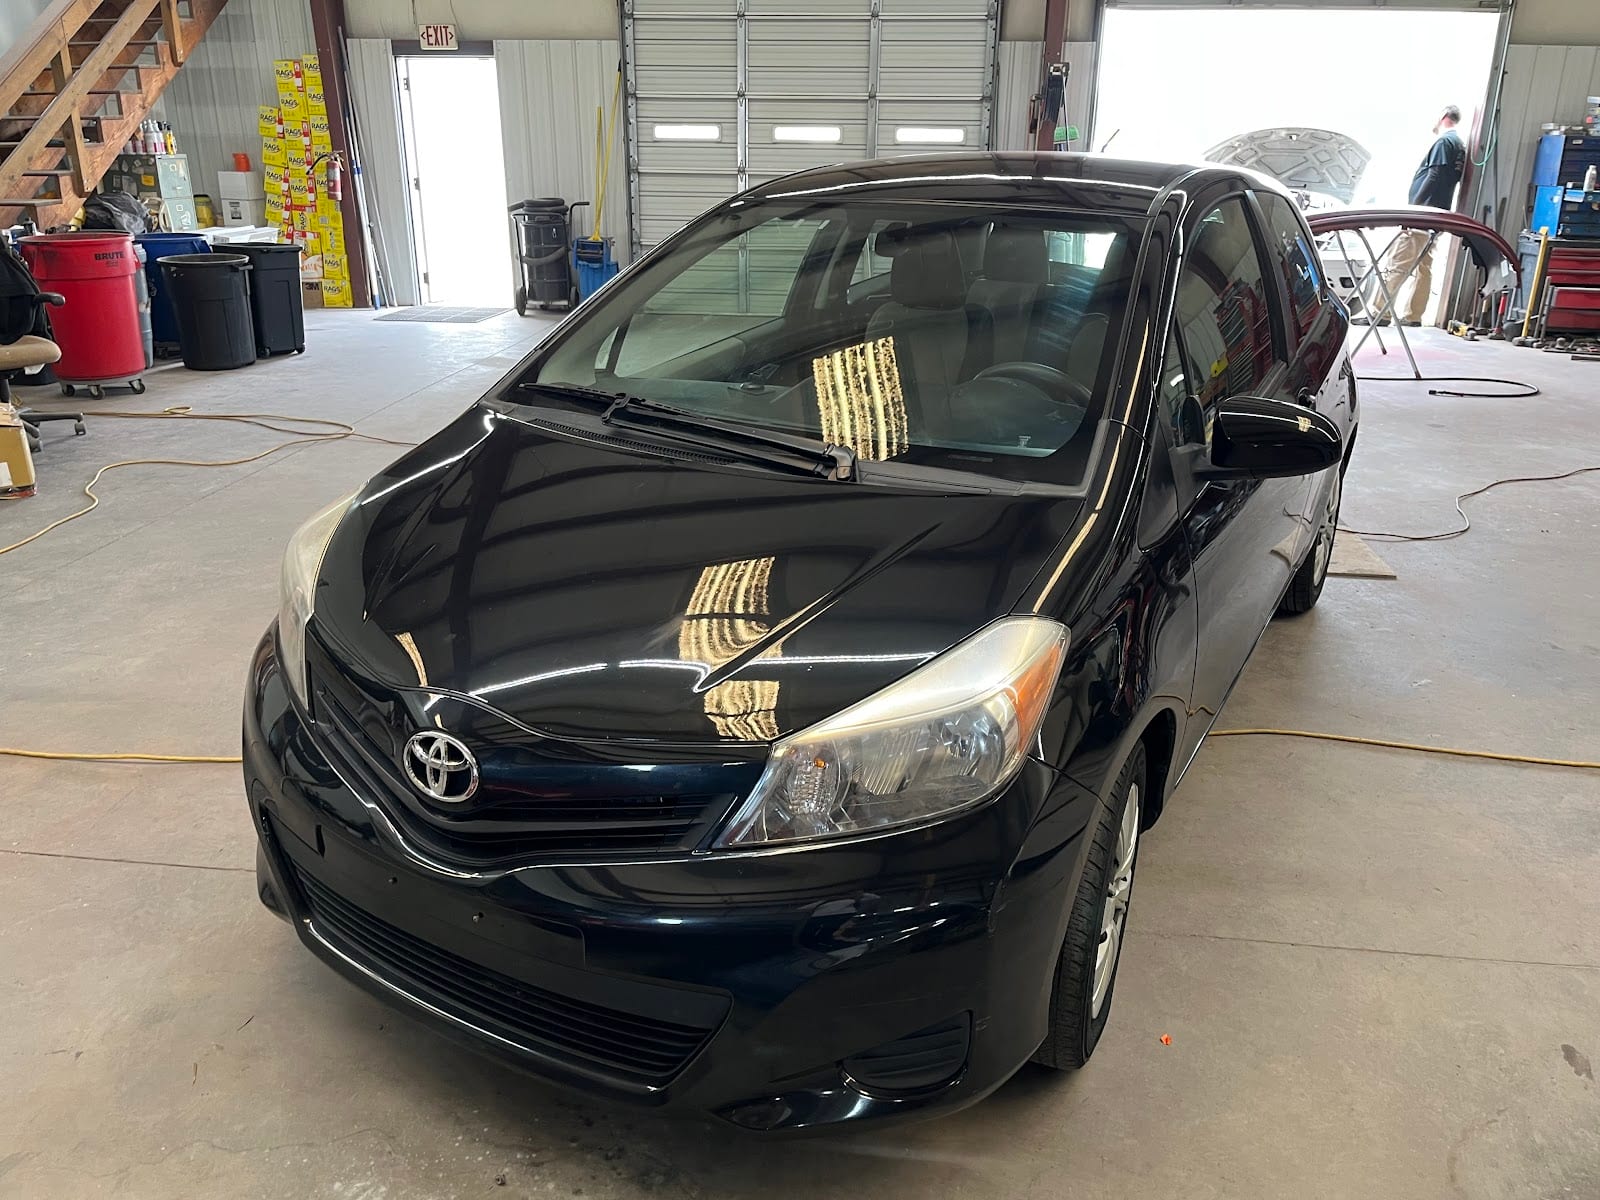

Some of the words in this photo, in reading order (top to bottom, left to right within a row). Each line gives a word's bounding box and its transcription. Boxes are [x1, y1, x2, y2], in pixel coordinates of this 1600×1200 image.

[425, 25, 449, 46] EXIT
[275, 69, 294, 78] RAGS
[281, 98, 298, 107] RAGS
[260, 113, 277, 122] RAGS
[311, 122, 329, 130] RAGS
[285, 128, 302, 136] RAGS
[264, 142, 280, 151] RAGS
[288, 157, 305, 165] RAGS
[266, 170, 283, 180] RAGS
[290, 184, 307, 192] RAGS
[267, 198, 284, 207] RAGS
[94, 251, 126, 260] BRUTE
[324, 259, 339, 268] RAGS
[305, 282, 320, 291] 3M
[323, 285, 341, 293] RAGS
